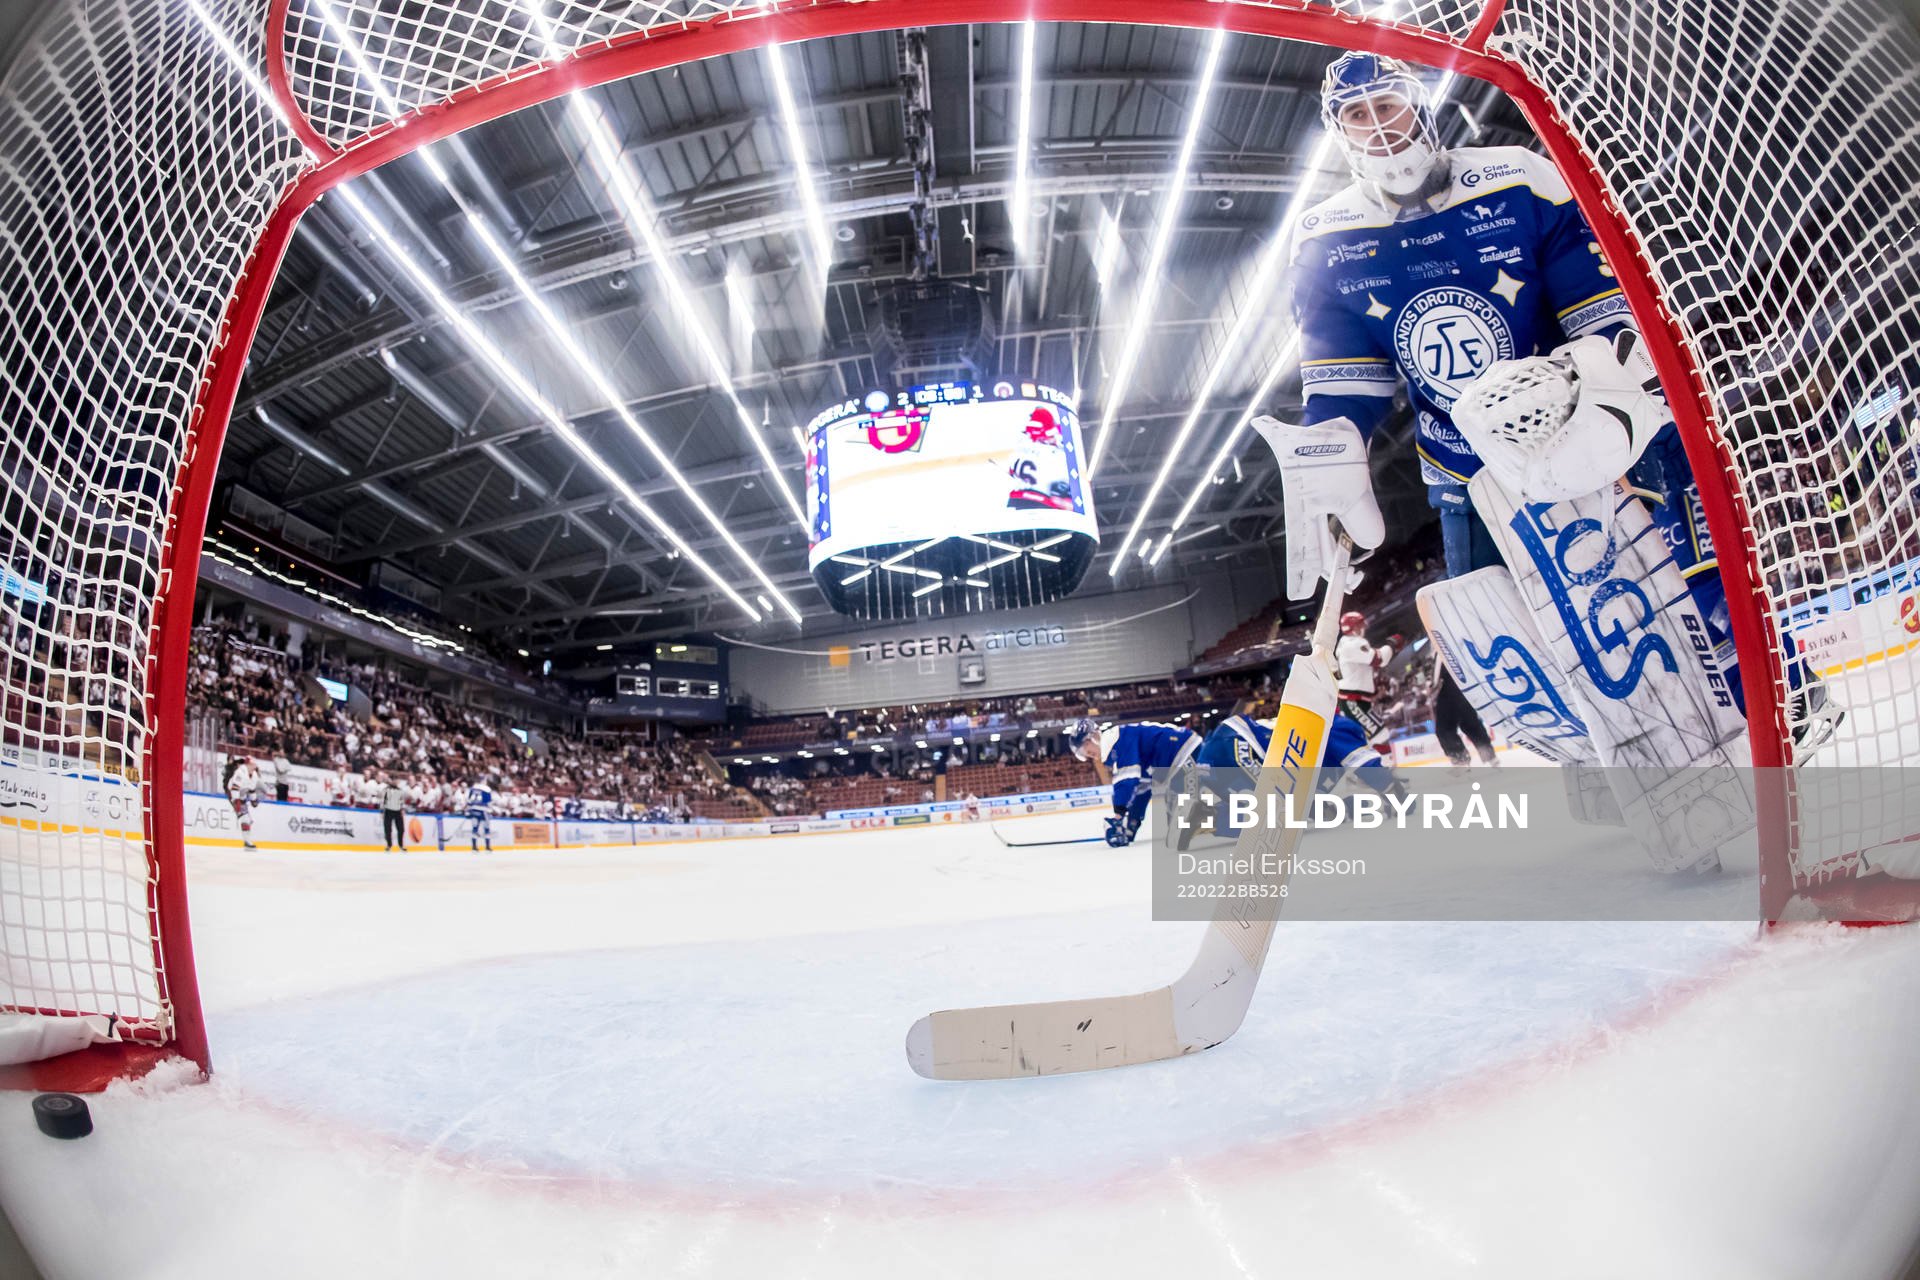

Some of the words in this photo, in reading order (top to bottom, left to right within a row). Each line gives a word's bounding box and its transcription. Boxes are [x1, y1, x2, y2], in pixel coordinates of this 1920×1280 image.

[1483, 164, 1509, 173] Clas
[1485, 168, 1526, 180] Ohlson
[1465, 217, 1517, 236] LEKSANDS
[1479, 246, 1521, 263] dalakraft
[1397, 310, 1425, 387] LKSANDS
[1413, 290, 1513, 360] IDROTTSFÖRENIN
[860, 633, 976, 661] TEGERA
[984, 623, 1067, 650] arena
[1680, 613, 1732, 708] BAUER
